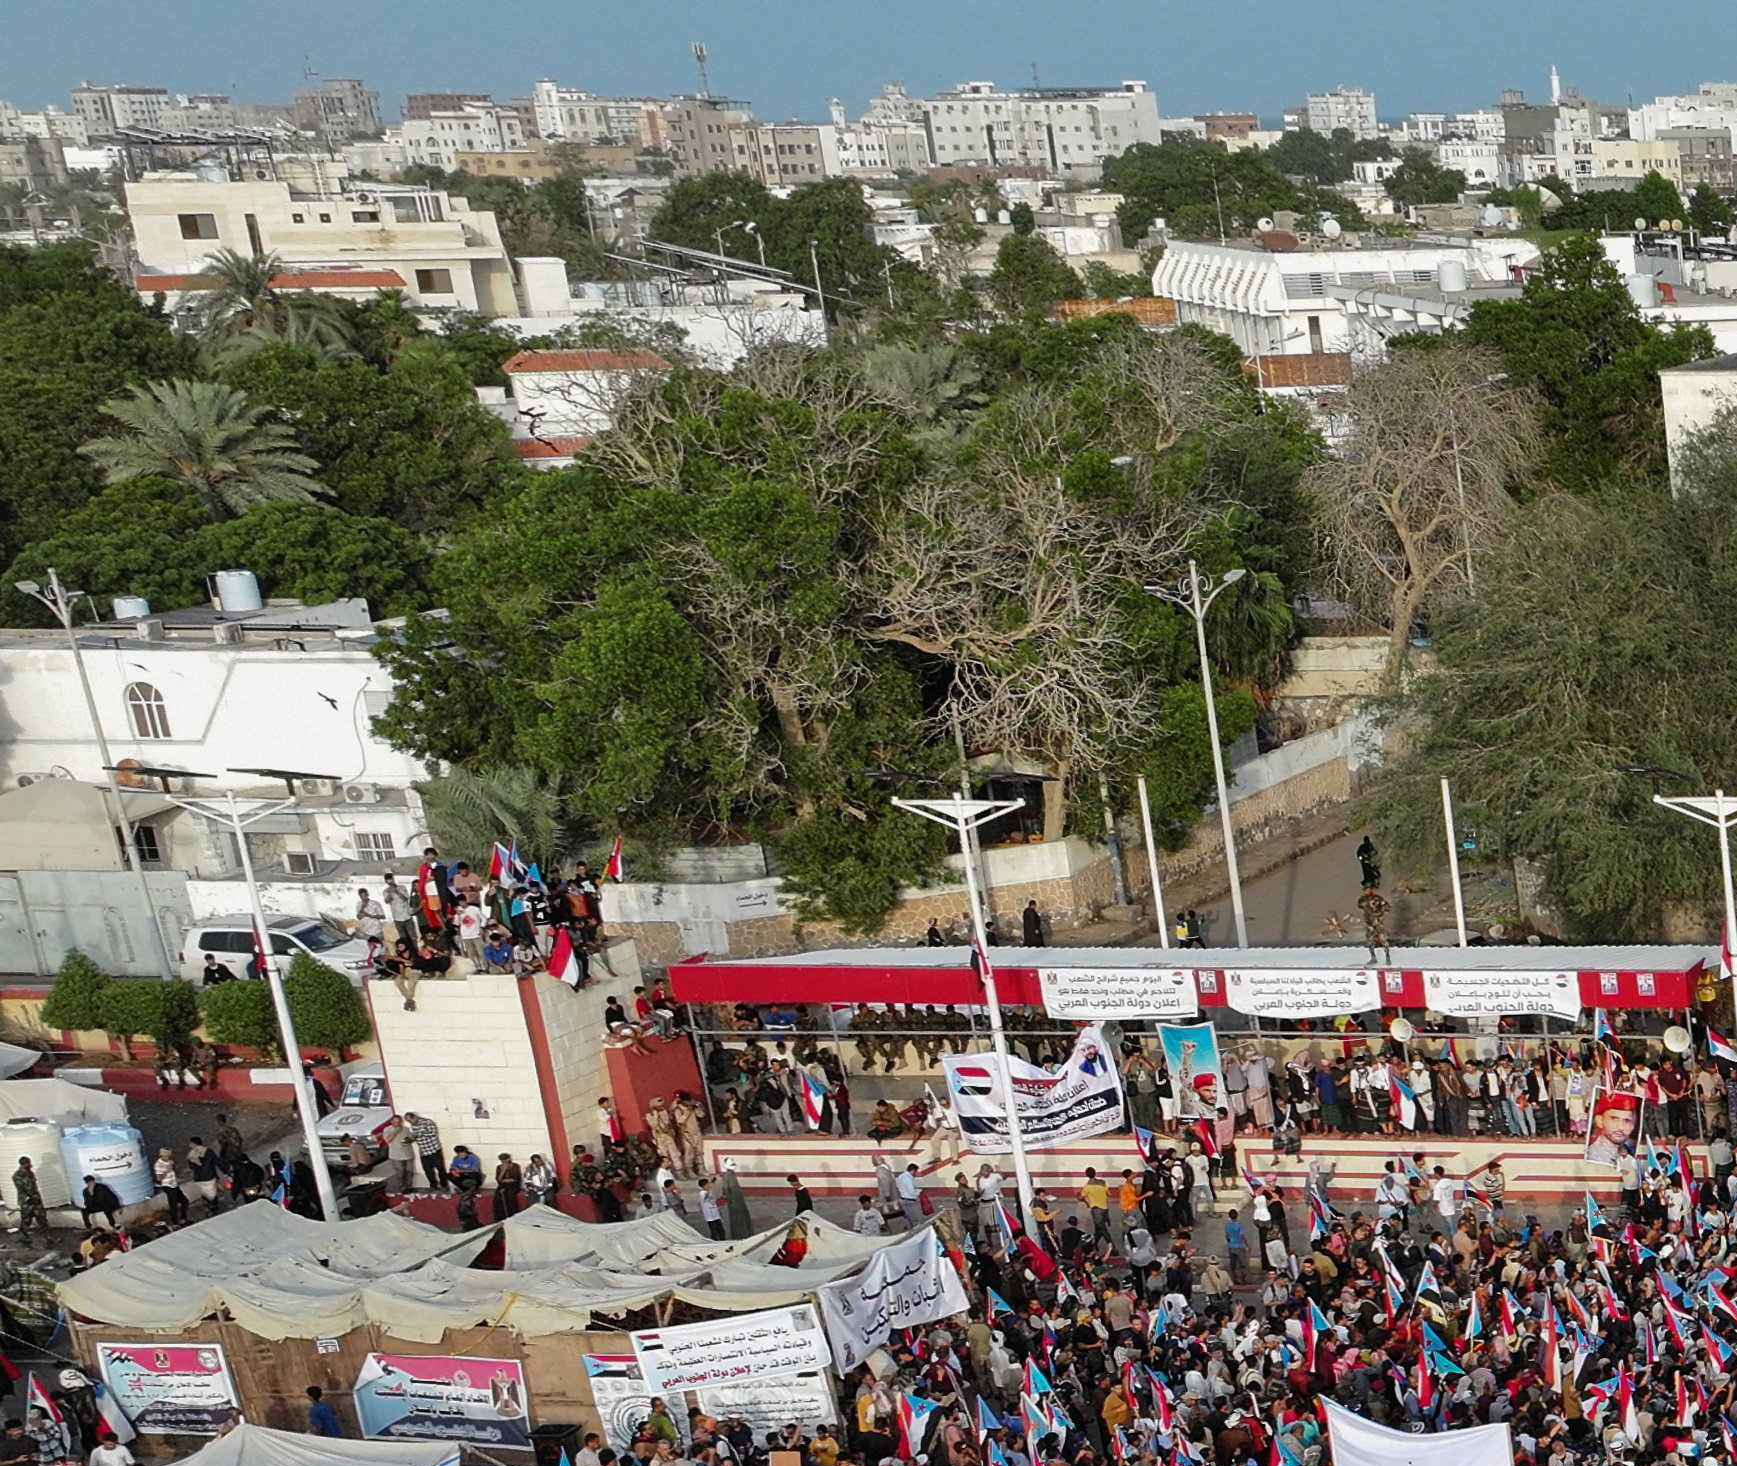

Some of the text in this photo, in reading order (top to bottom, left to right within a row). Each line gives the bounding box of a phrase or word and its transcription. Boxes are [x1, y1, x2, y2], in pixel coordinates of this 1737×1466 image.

[1058, 998, 1088, 1011] العربي
[1090, 998, 1124, 1009] الجنوب
[1127, 998, 1150, 1009] دولة
[1254, 998, 1352, 1011] دولة الجنوب العربي
[669, 1340, 697, 1355] الجنوبي
[749, 1343, 781, 1356] السياسية
[769, 1359, 781, 1369] قد
[782, 1356, 802, 1368] الوقت
[685, 1369, 710, 1385] الجنوب
[712, 1368, 729, 1381] دولة
[661, 1375, 685, 1390] العربي
